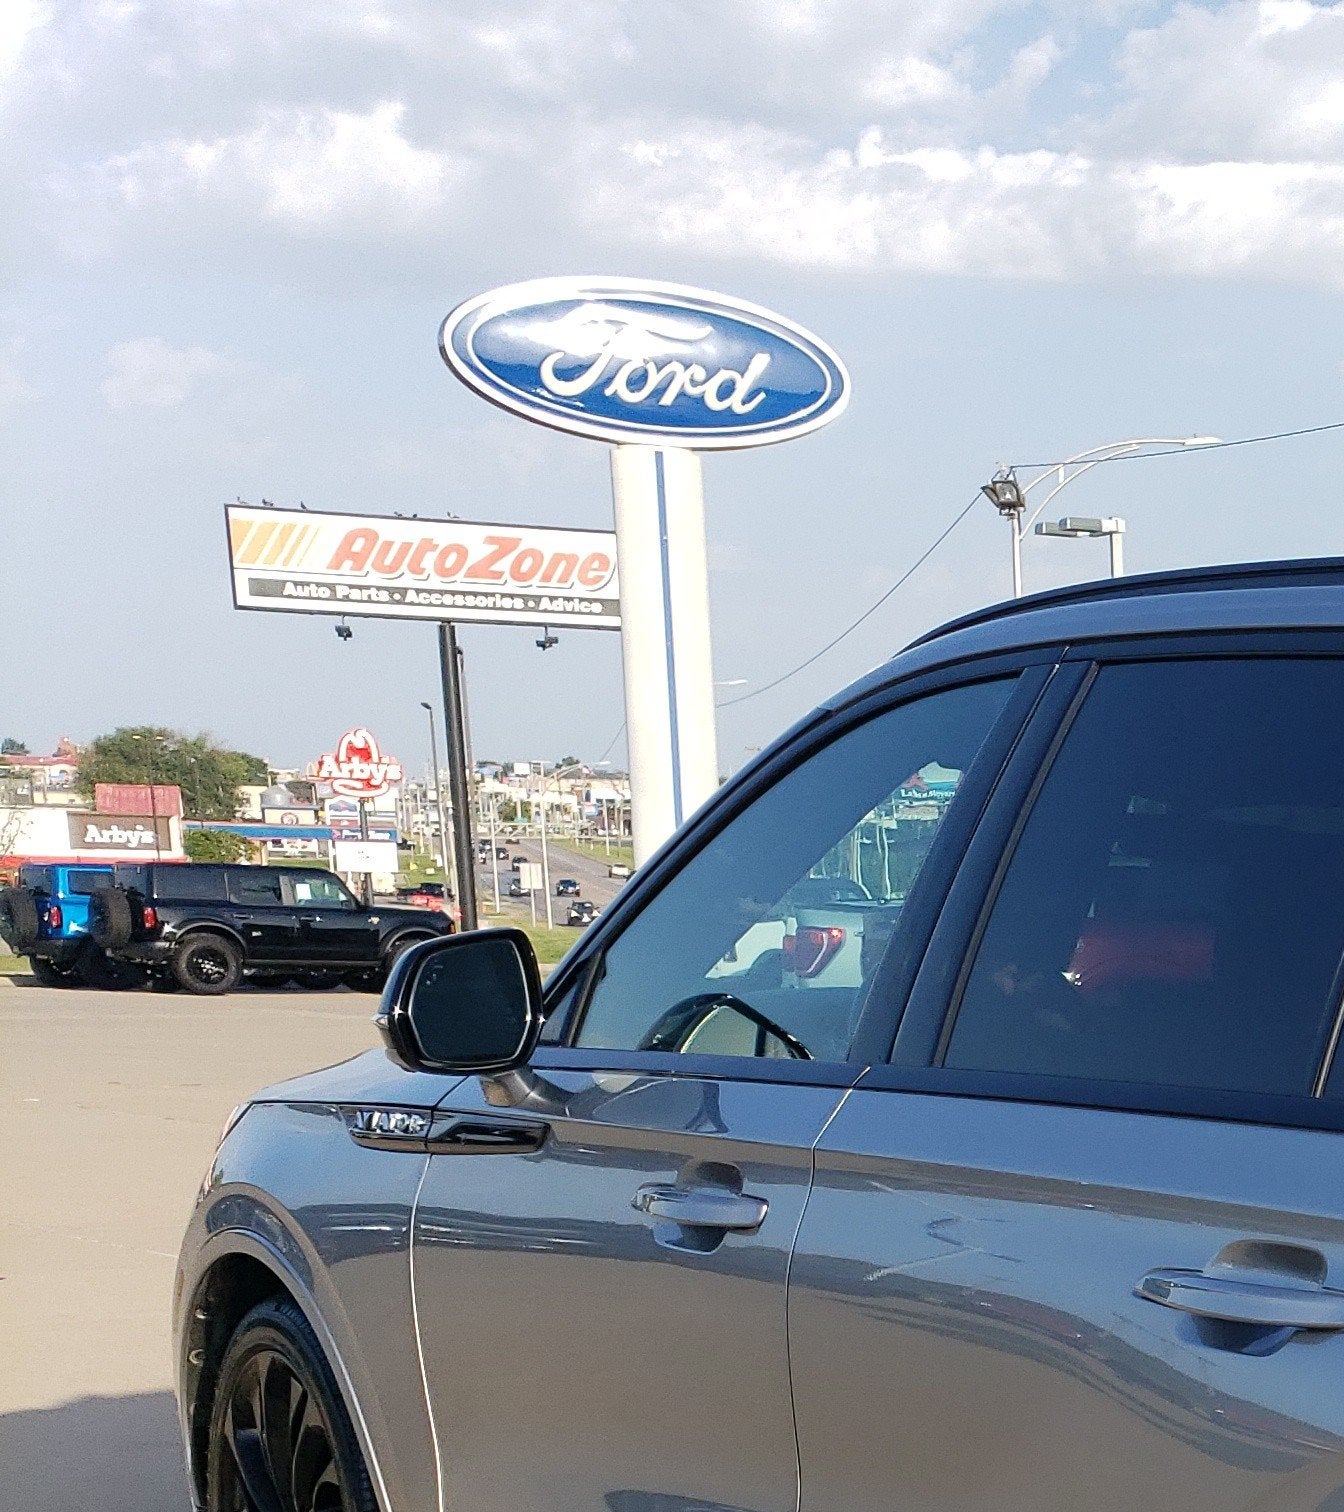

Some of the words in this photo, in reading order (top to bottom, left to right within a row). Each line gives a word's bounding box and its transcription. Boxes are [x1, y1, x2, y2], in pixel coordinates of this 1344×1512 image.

[540, 302, 772, 415] Ford
[326, 527, 613, 588] AutoZone
[283, 581, 331, 598] Auto
[336, 584, 390, 602] Parts
[405, 589, 525, 610] Accessories
[538, 597, 603, 614] Advice
[319, 754, 403, 787] Arby's
[84, 824, 155, 848] Arby's
